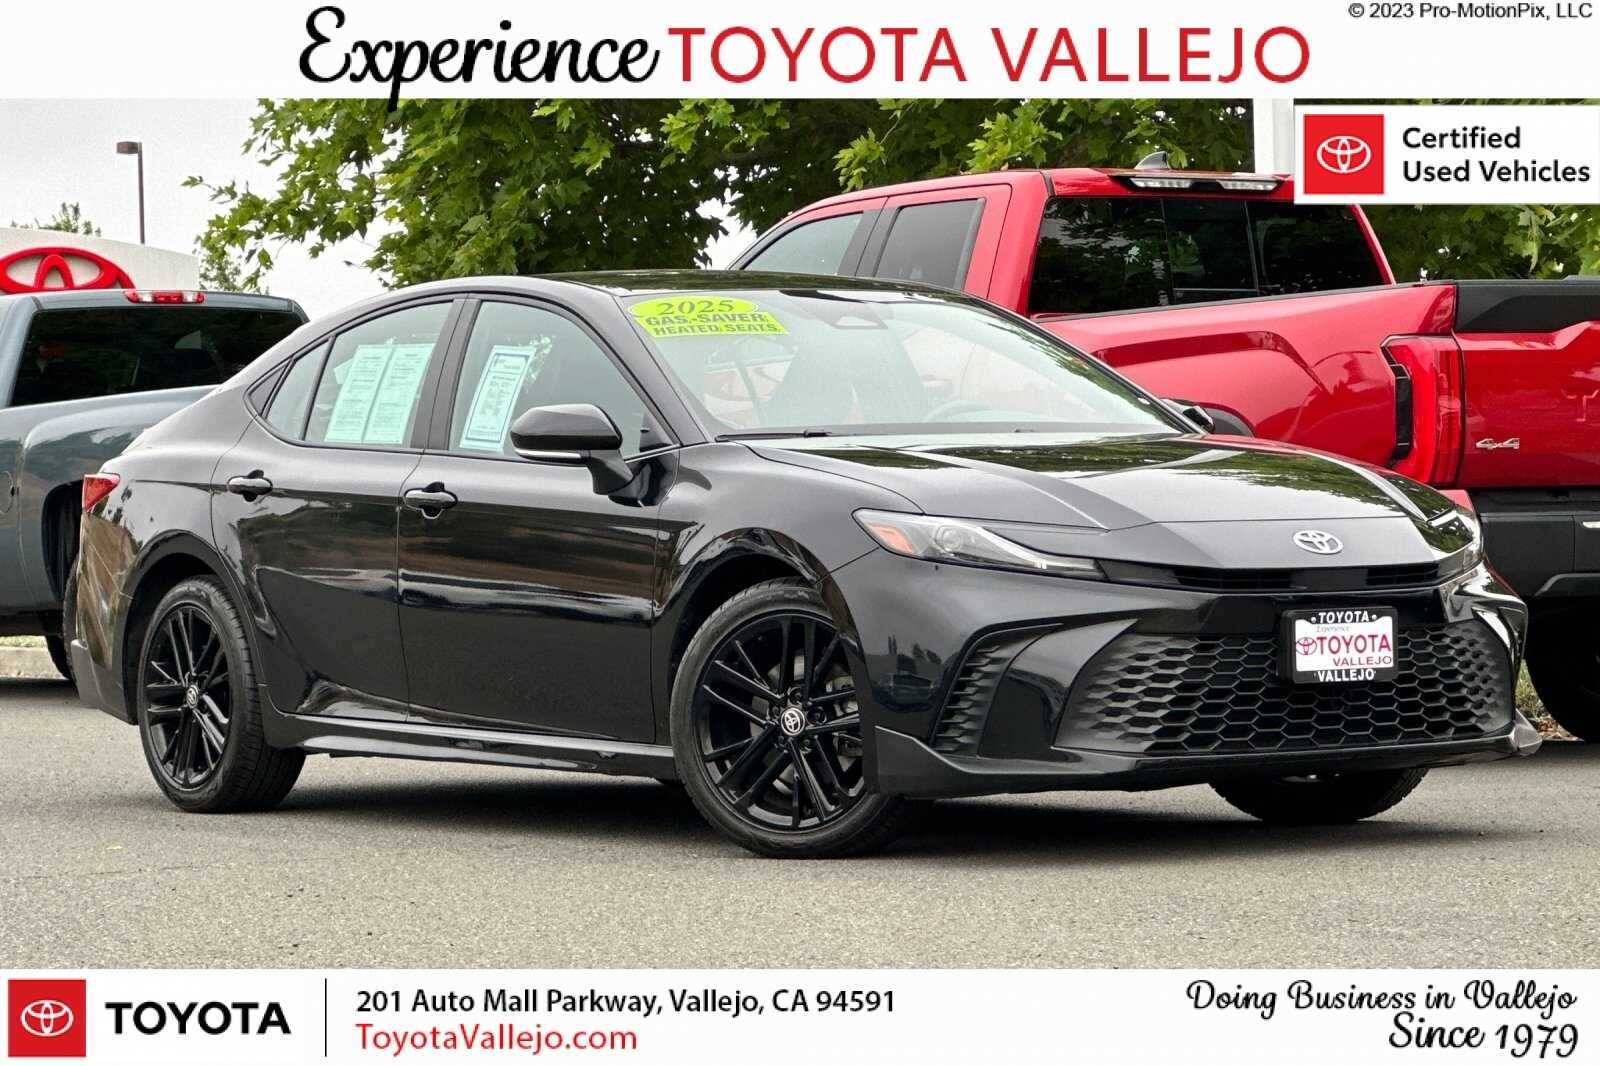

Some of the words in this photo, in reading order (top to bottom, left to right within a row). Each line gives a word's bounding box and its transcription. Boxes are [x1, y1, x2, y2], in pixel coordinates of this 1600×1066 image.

[656, 299, 735, 316] 2025
[653, 324, 719, 336] HEATED
[724, 322, 778, 333] SEATS
[1318, 610, 1370, 624] TOYOTA
[1316, 634, 1392, 655] TOYOTA
[1333, 655, 1393, 667] VALLEJO
[1317, 668, 1375, 682] VALLEJO
